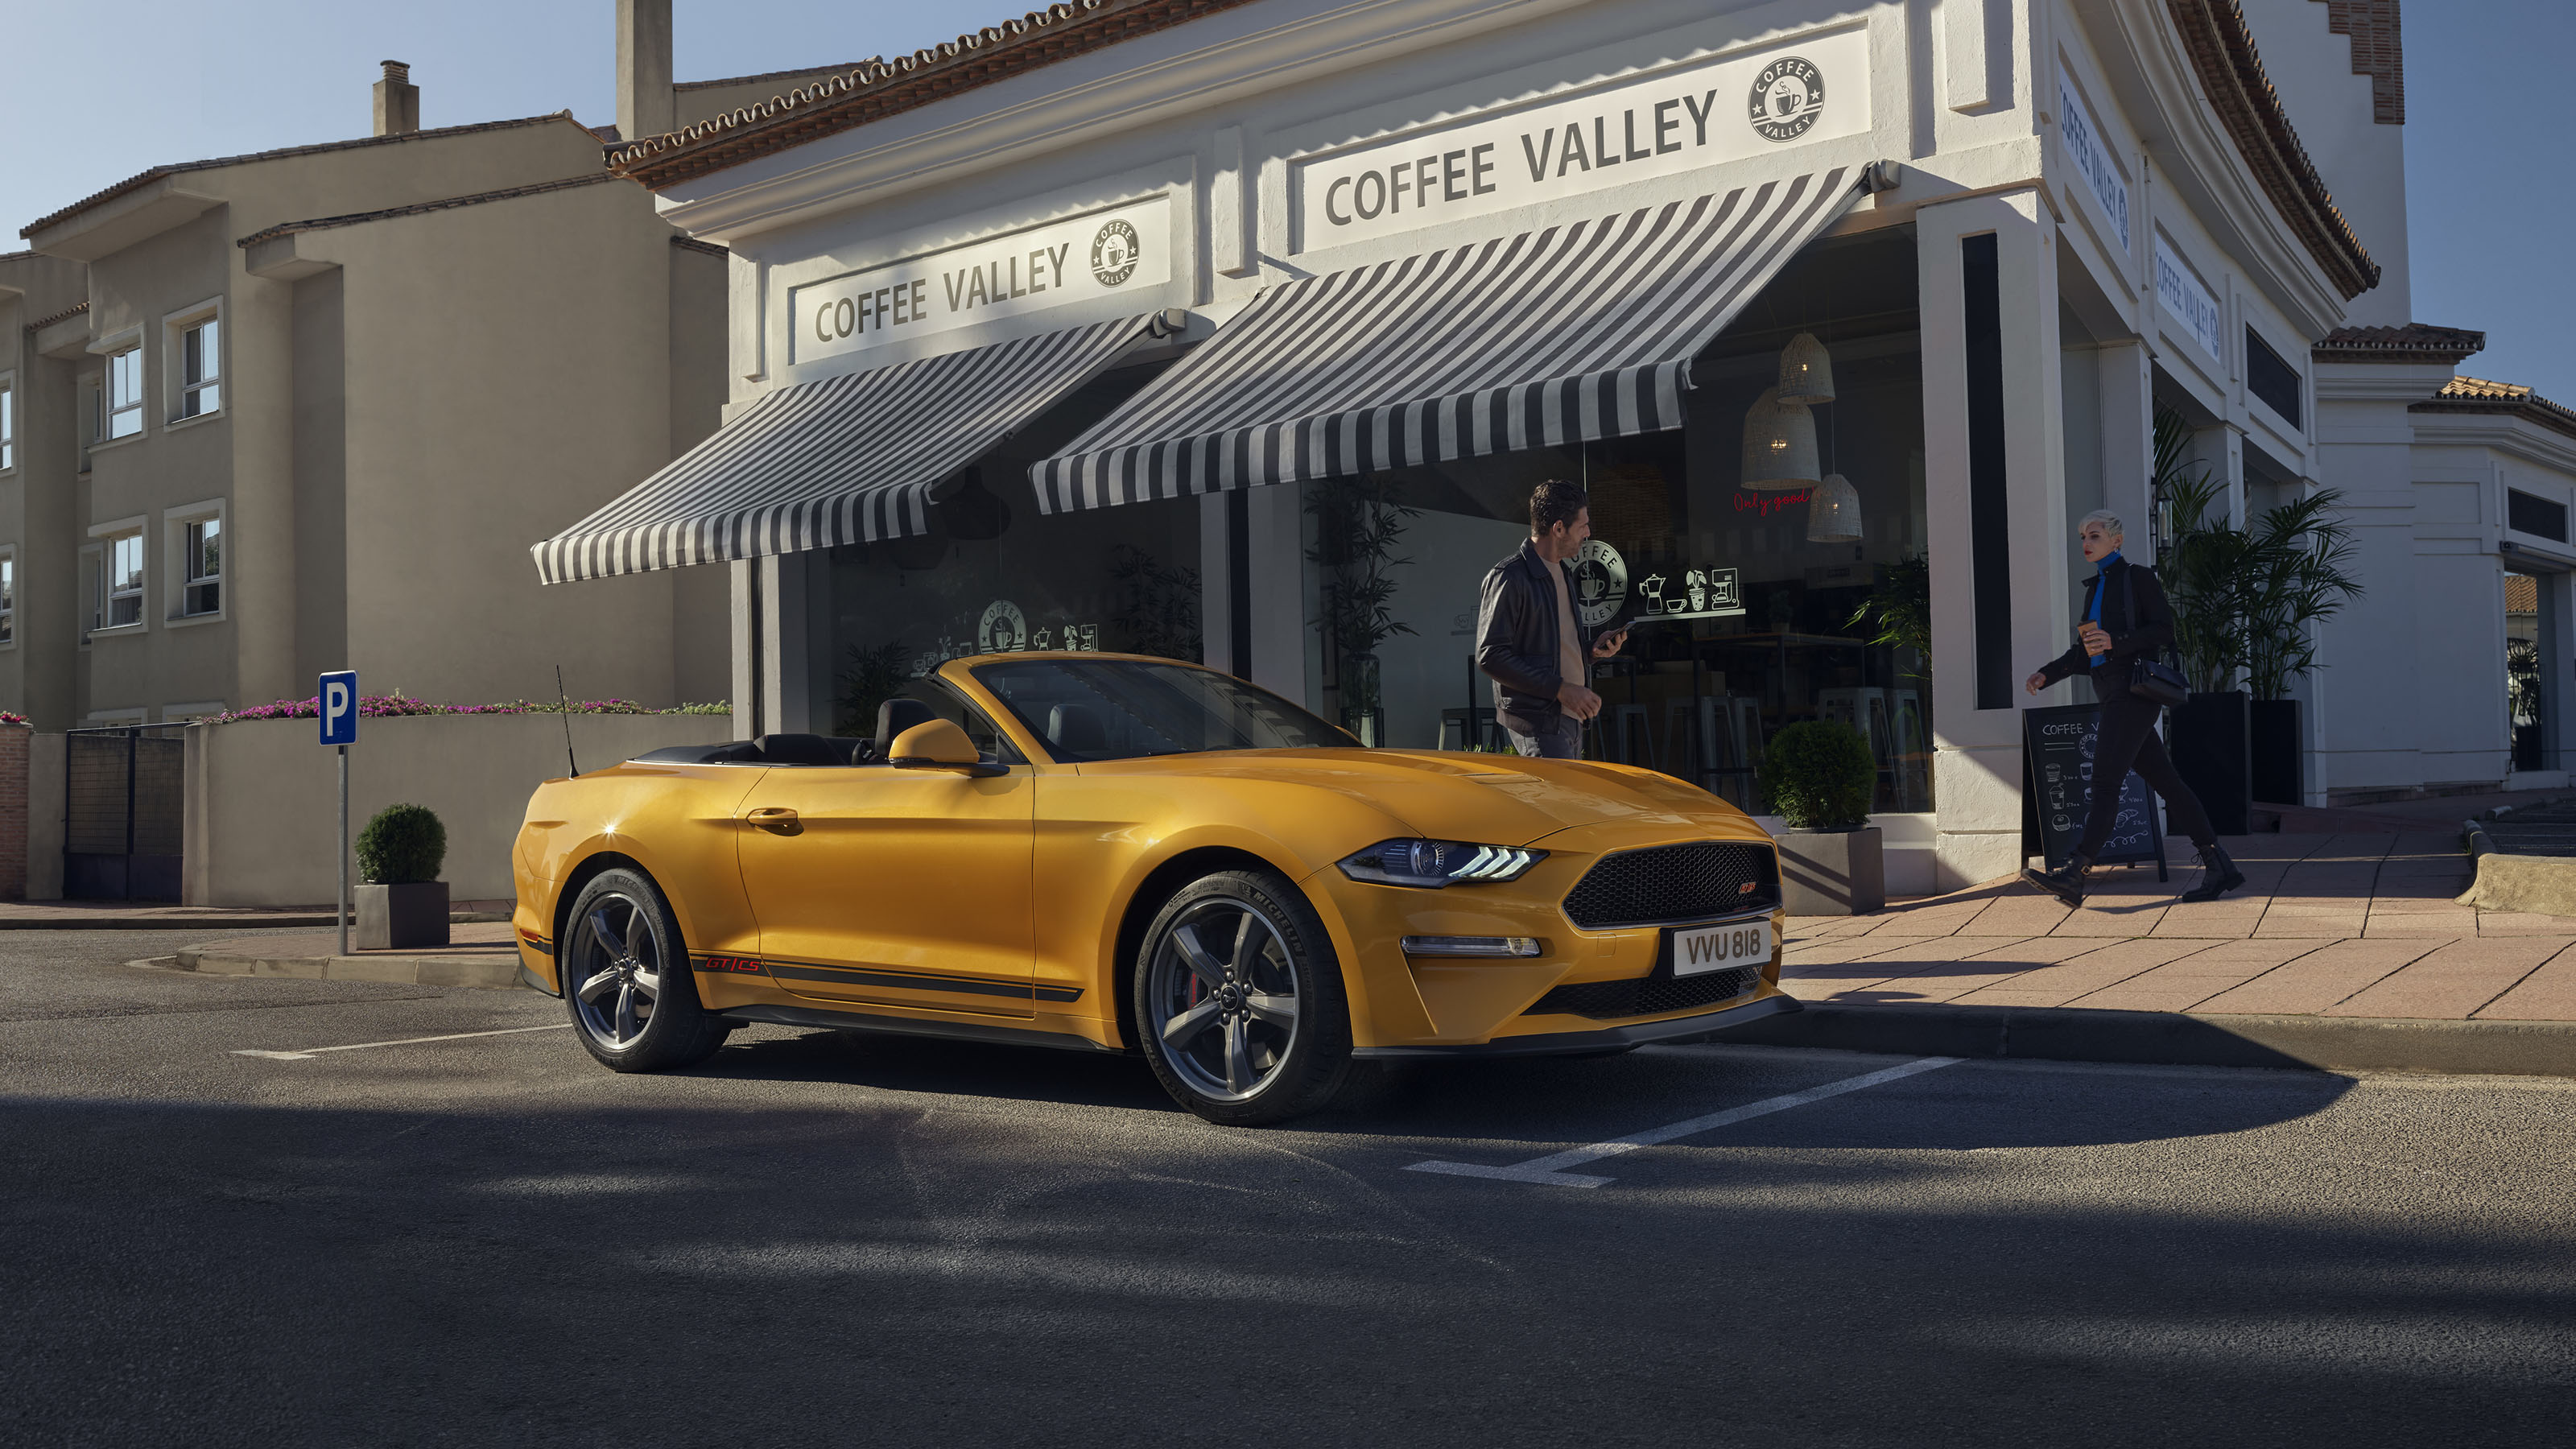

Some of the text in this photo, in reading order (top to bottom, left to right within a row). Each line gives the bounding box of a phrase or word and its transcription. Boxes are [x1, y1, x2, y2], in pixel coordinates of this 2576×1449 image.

[1756, 61, 1814, 93] COFFEE
[1765, 116, 1810, 138] VALLEY
[1325, 89, 1718, 226] COFFEE VALLEY
[2090, 141, 2116, 224] VALLEY
[1096, 222, 1133, 247] COFFEE
[1100, 266, 1130, 284] VALLEY
[815, 242, 1070, 343] COFFEE VALLEY
[2183, 283, 2209, 339] VALLEY
[1733, 492, 1770, 517] Only
[1773, 488, 1810, 512] good
[984, 605, 1020, 626] COFFEE
[1584, 604, 1613, 621] LLEY
[327, 682, 349, 737] P
[2042, 723, 2083, 736] COFFEE
[1253, 890, 1303, 954] MICHELIN
[1686, 929, 1761, 964] VVU 818
